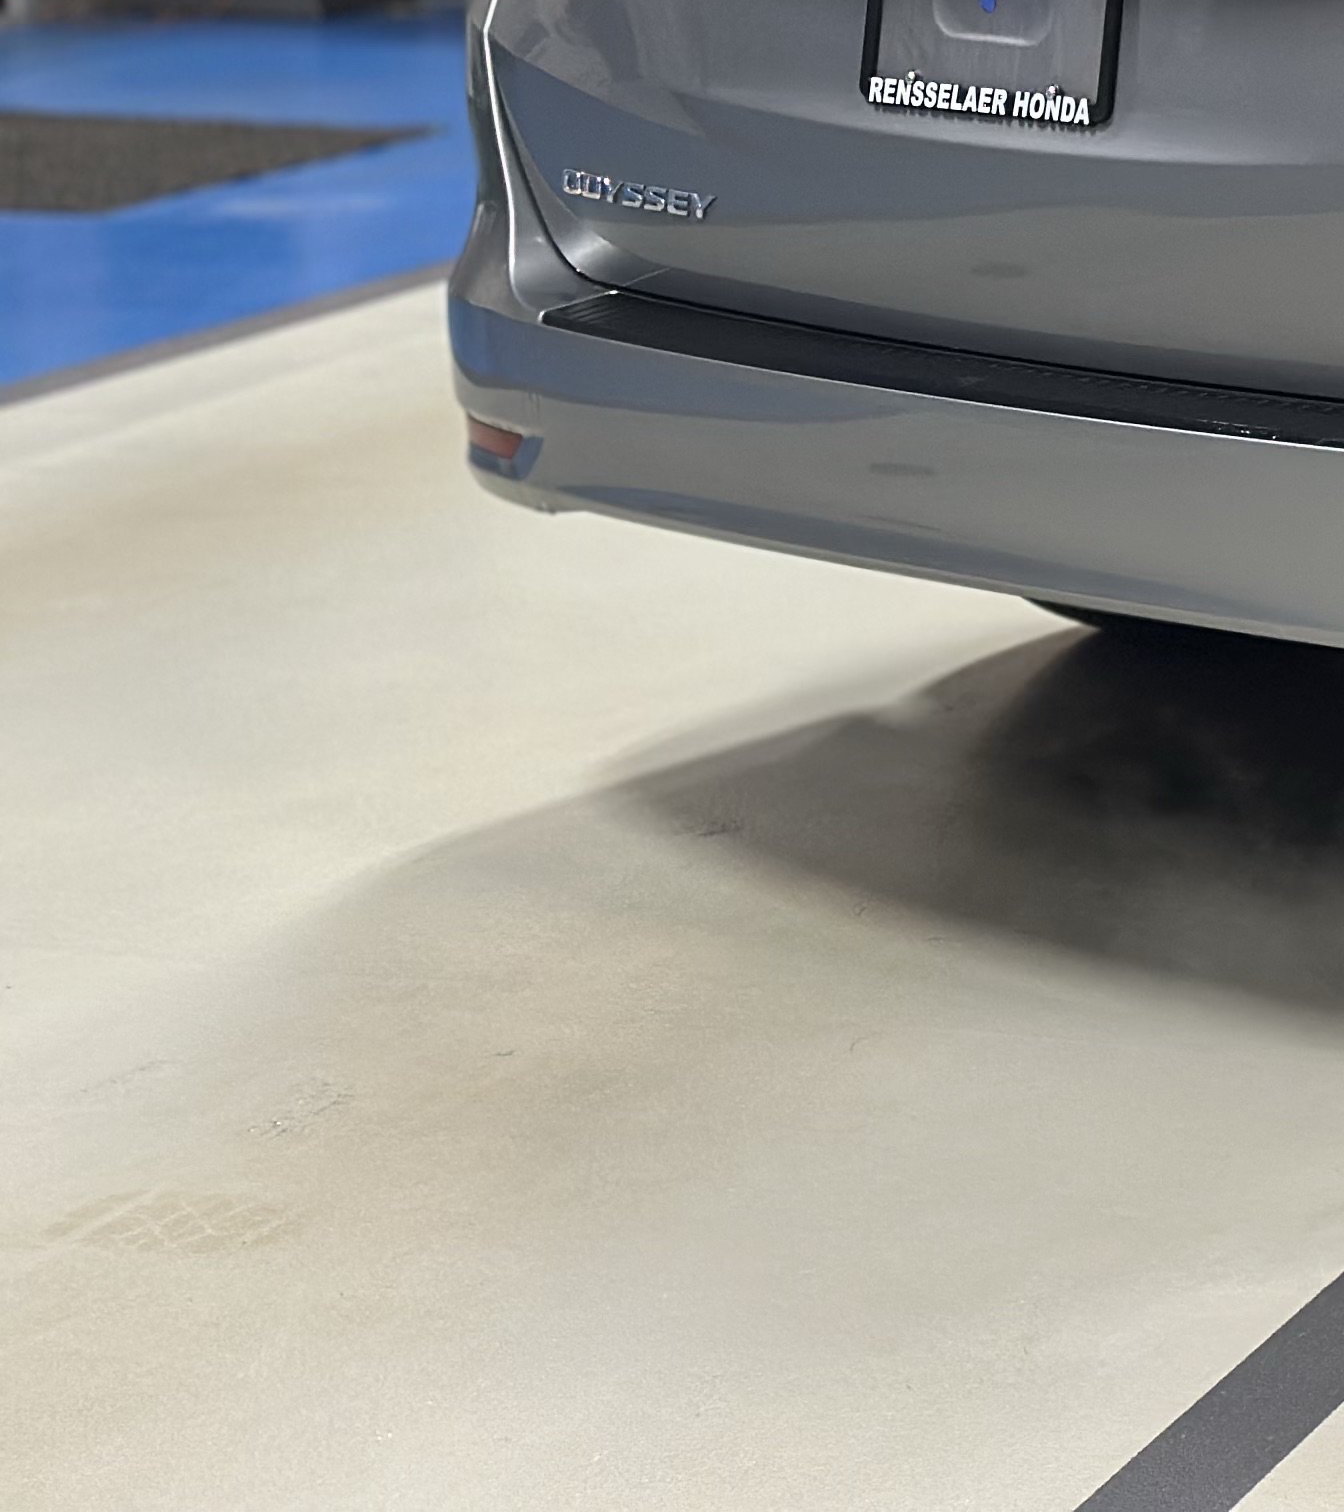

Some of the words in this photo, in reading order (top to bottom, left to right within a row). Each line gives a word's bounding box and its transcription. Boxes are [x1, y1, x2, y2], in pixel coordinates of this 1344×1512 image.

[868, 76, 1006, 116] RENSSELAER
[1012, 90, 1090, 125] HONDA
[563, 169, 716, 218] ODYSSEY
